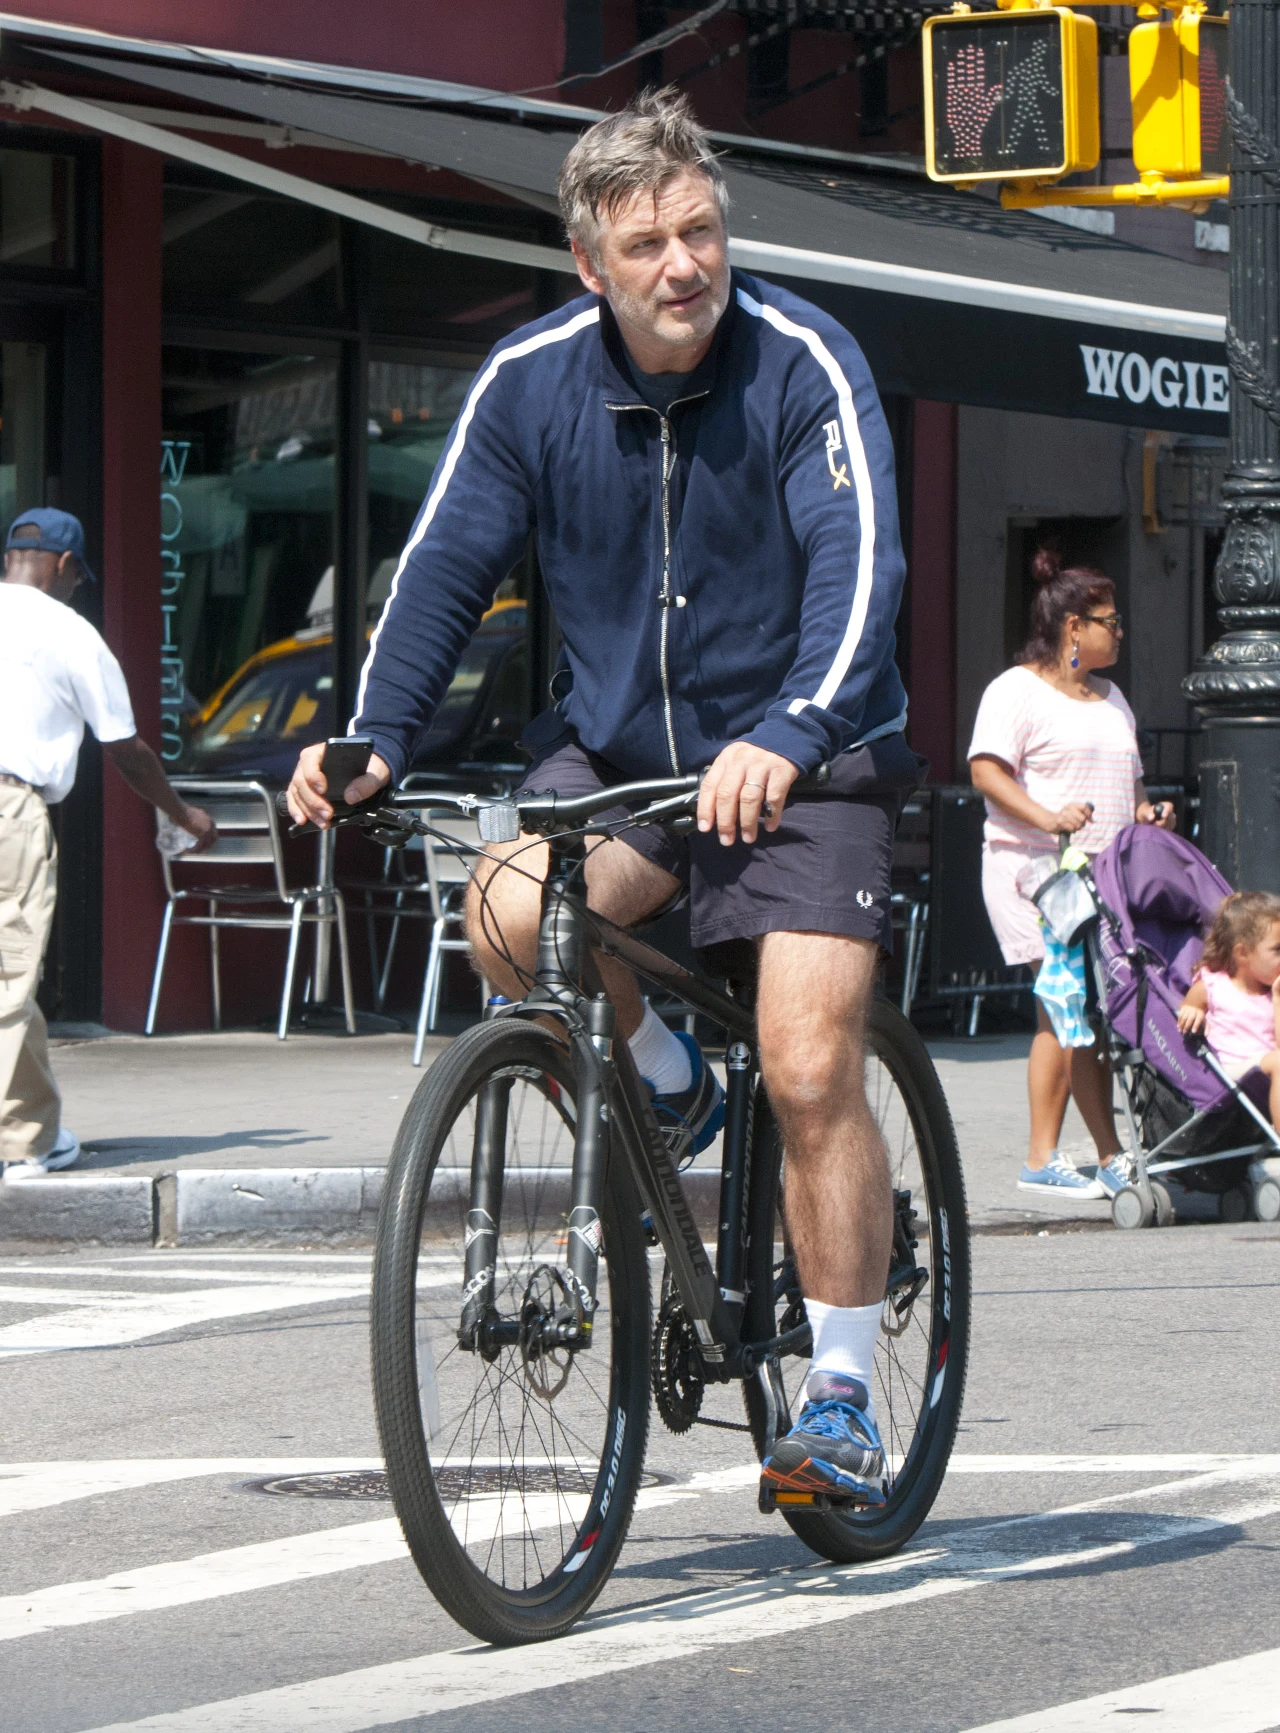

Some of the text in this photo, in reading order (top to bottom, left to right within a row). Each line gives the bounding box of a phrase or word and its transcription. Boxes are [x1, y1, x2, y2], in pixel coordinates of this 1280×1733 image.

[1079, 344, 1229, 413] WOGIE
[822, 419, 851, 491] RLX
[1148, 1019, 1188, 1082] MACLAREN
